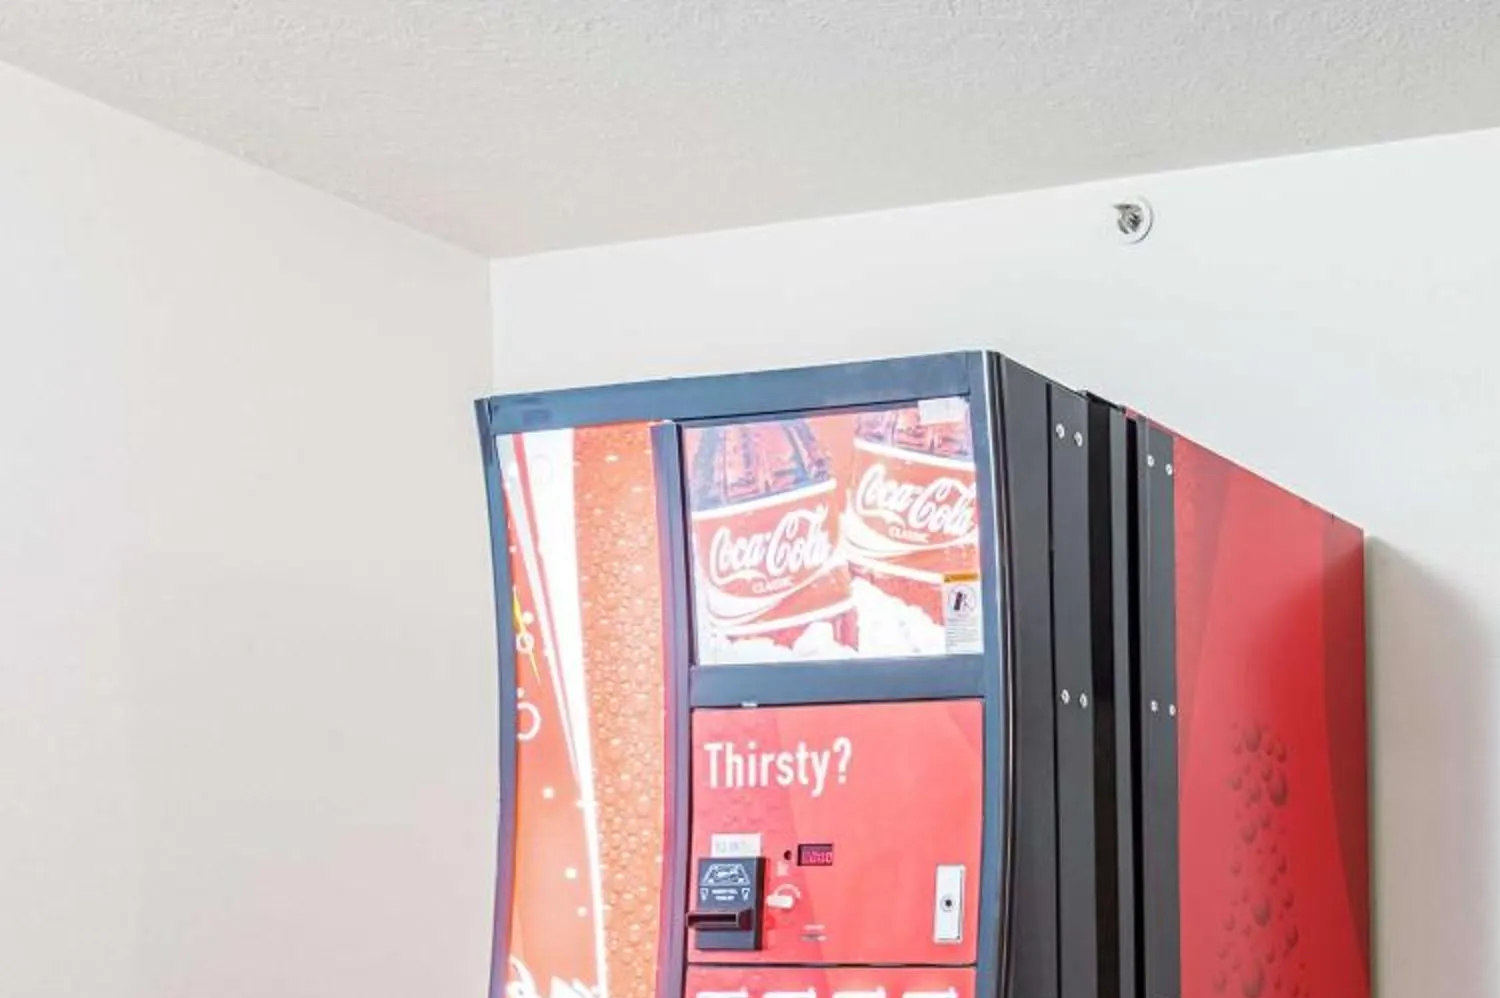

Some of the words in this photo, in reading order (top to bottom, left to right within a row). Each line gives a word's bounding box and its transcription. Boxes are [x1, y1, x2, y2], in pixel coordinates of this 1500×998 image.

[855, 463, 978, 538] Coca-Cola
[709, 503, 833, 589] Coca-Cola
[703, 736, 852, 798] Thirsty?
